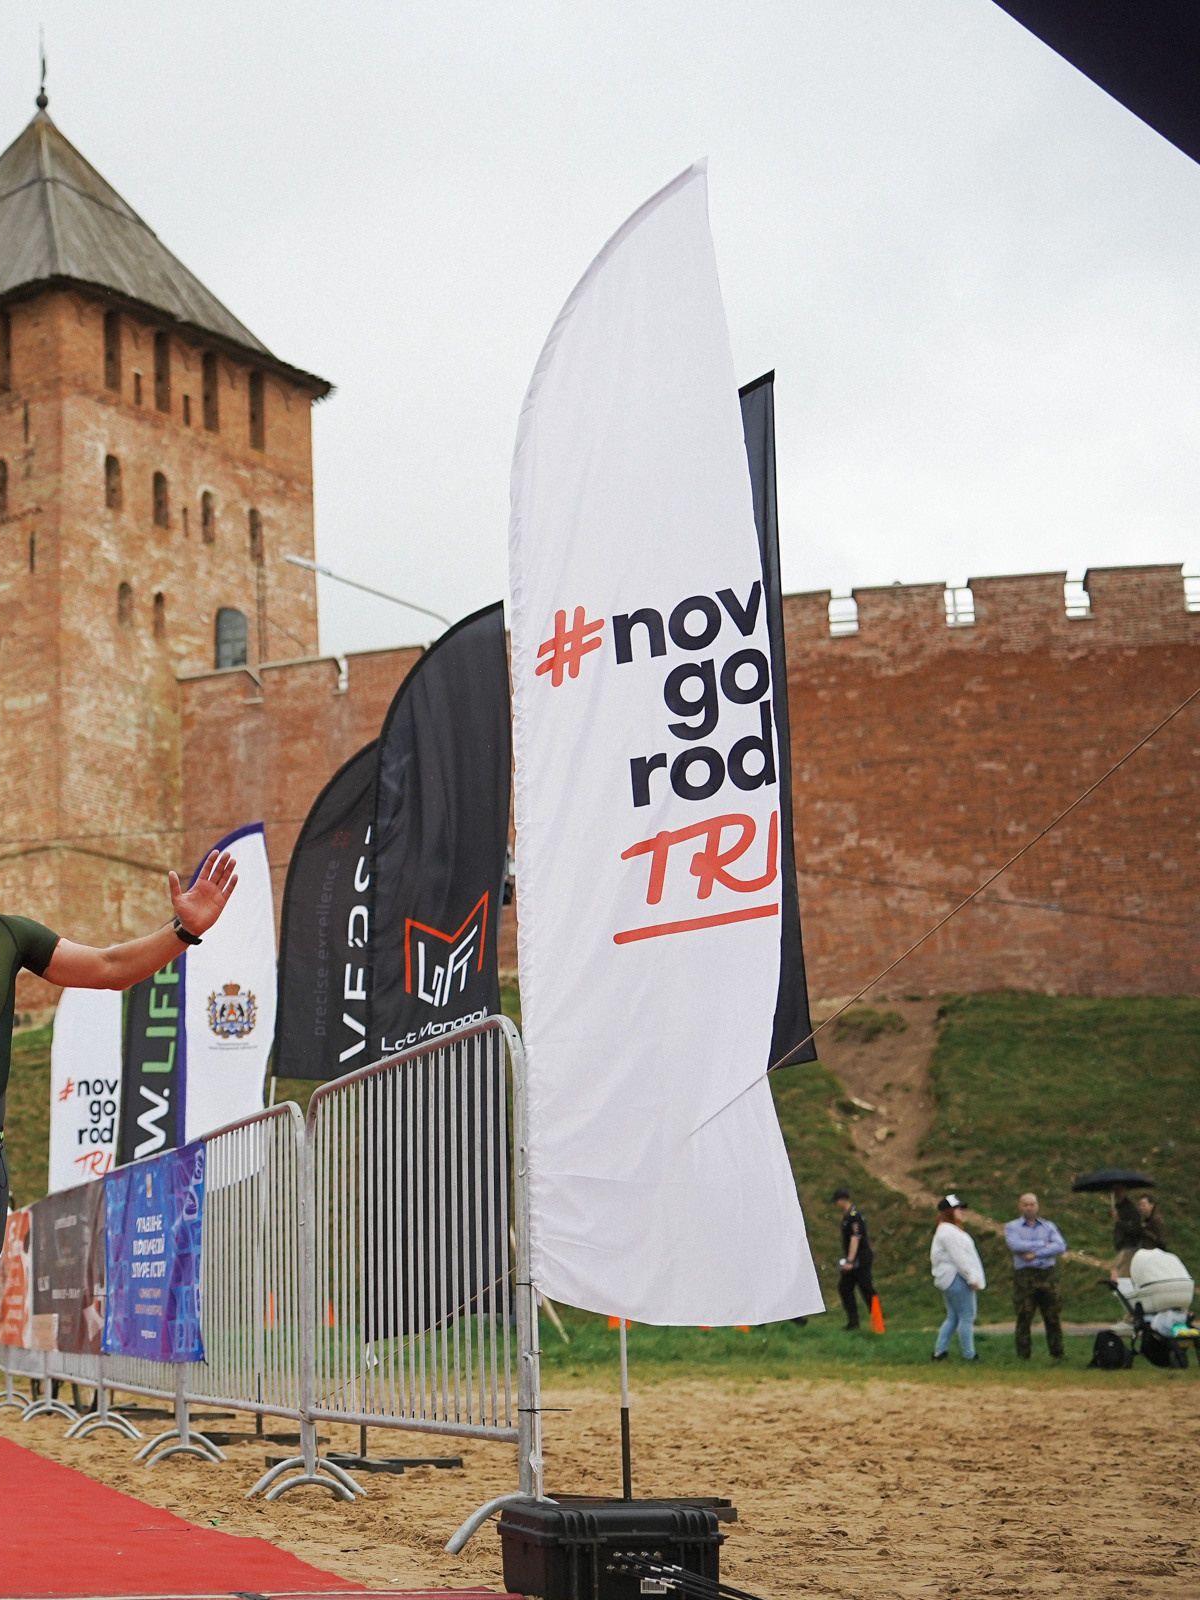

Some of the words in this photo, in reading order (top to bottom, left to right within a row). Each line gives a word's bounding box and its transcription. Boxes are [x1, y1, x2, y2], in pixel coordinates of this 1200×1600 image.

[535, 580, 762, 687] #nov
[663, 648, 770, 740] go
[629, 699, 777, 807] rod
[620, 812, 778, 905] TRI
[59, 1077, 118, 1102] #nov
[78, 1118, 115, 1145] rod
[89, 1100, 116, 1124] go
